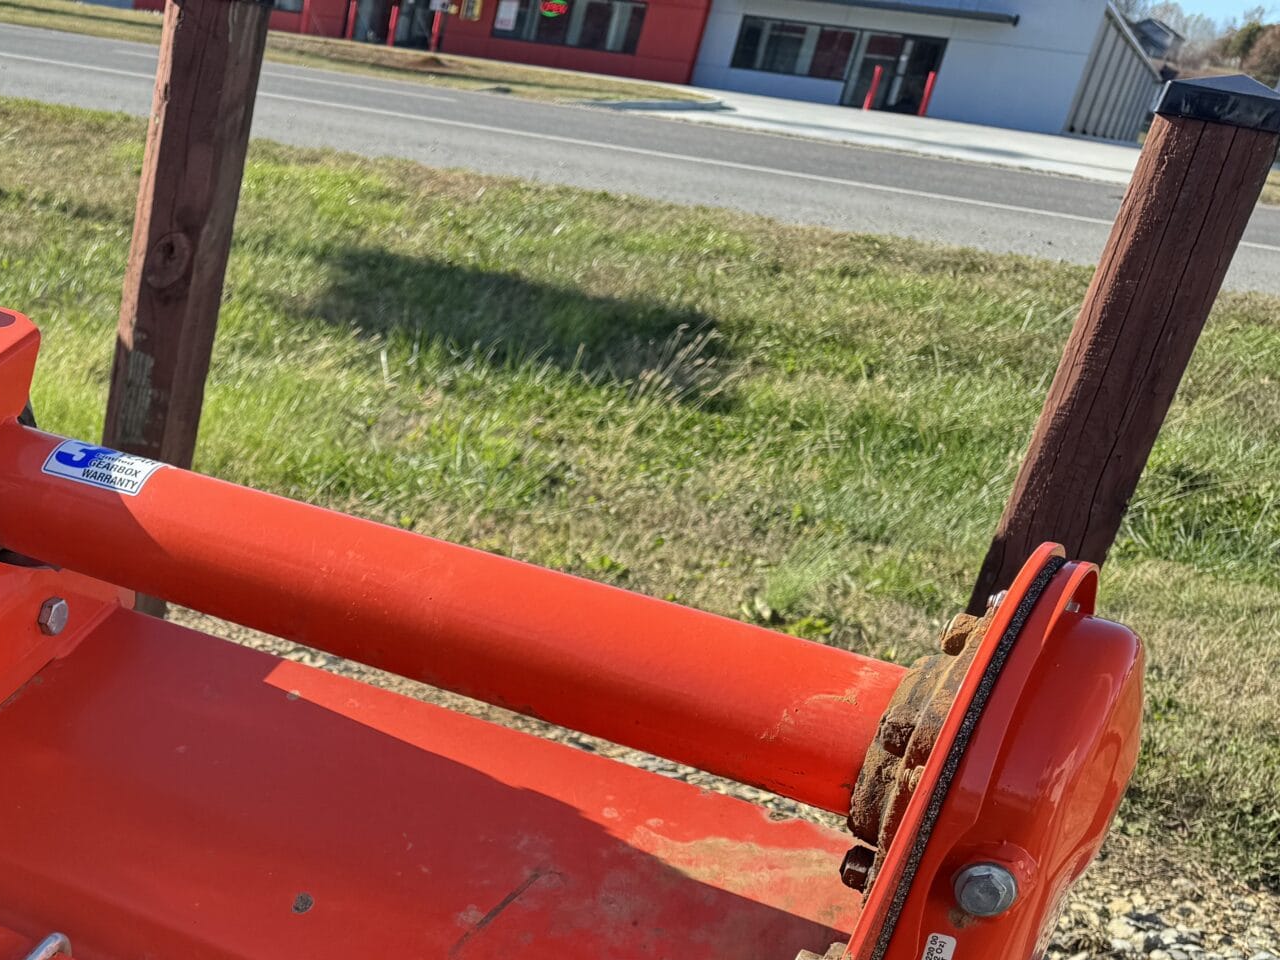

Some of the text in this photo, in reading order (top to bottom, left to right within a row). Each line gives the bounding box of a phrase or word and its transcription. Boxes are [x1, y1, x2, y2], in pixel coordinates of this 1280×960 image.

[88, 459, 141, 478] GEARBOX
[81, 468, 138, 489] WARRANTY
[930, 935, 938, 945] 00
[936, 940, 946, 954] Oz)
